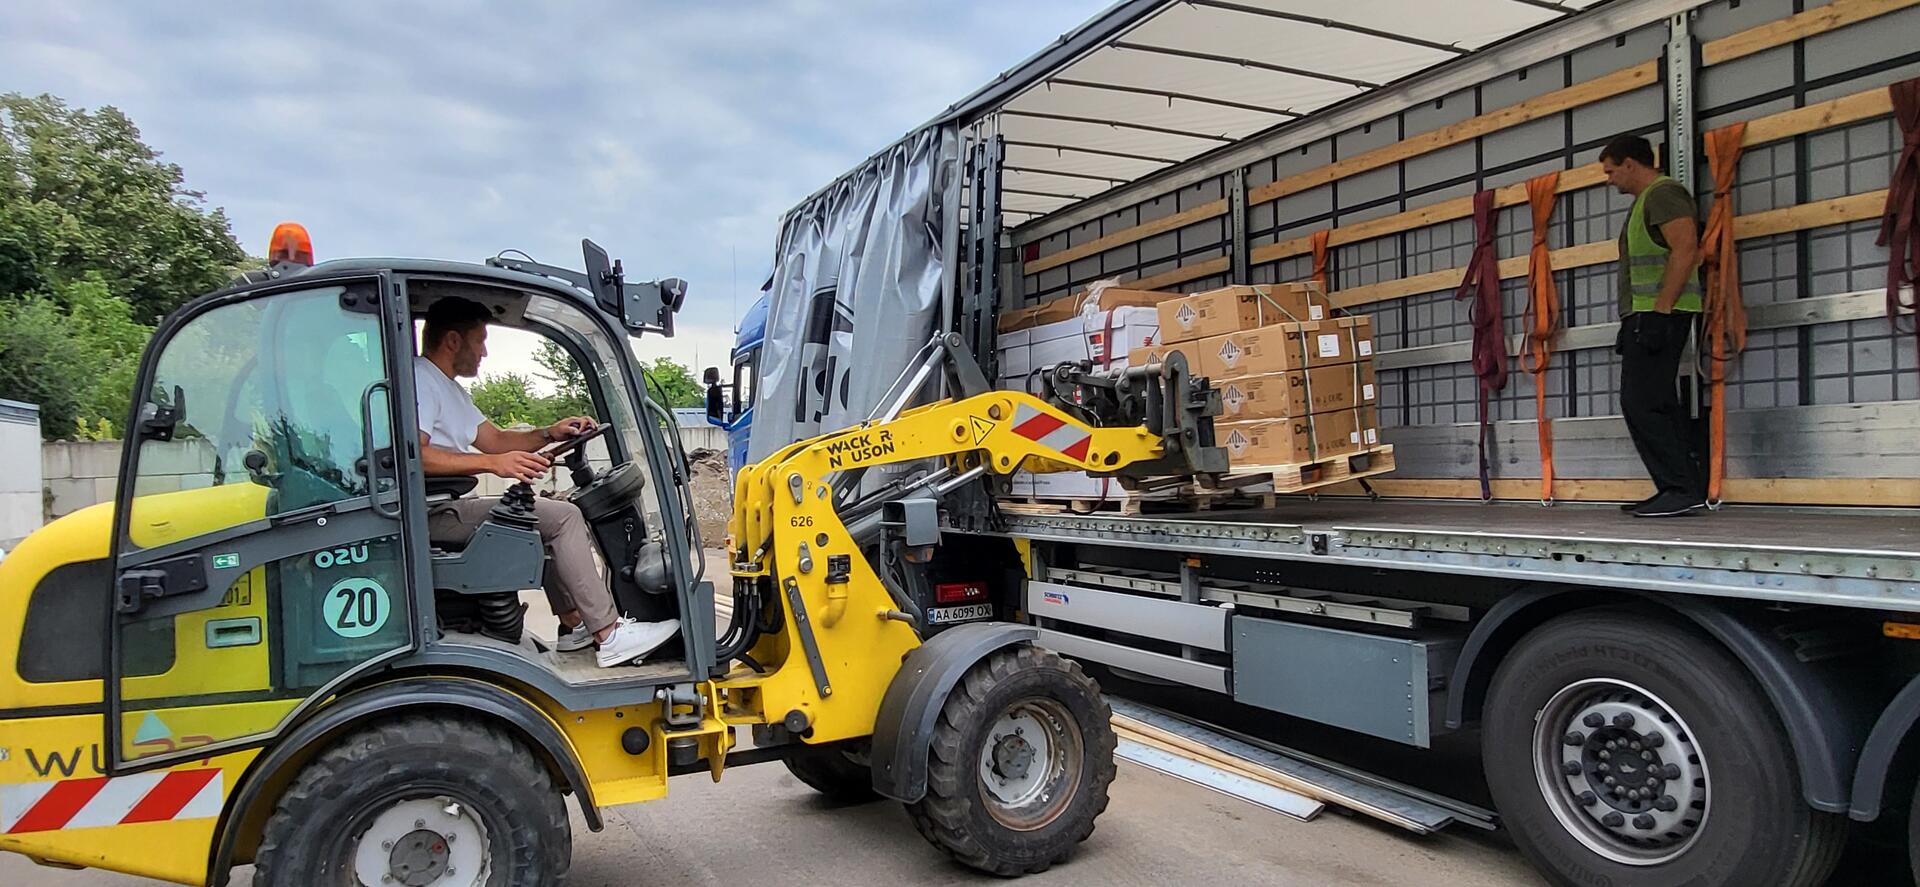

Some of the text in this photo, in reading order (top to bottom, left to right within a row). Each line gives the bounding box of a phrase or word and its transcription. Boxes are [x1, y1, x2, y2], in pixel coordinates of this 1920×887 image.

[791, 516, 813, 527] 626
[336, 587, 377, 629] 20
[936, 604, 991, 621] AA 6099 OX
